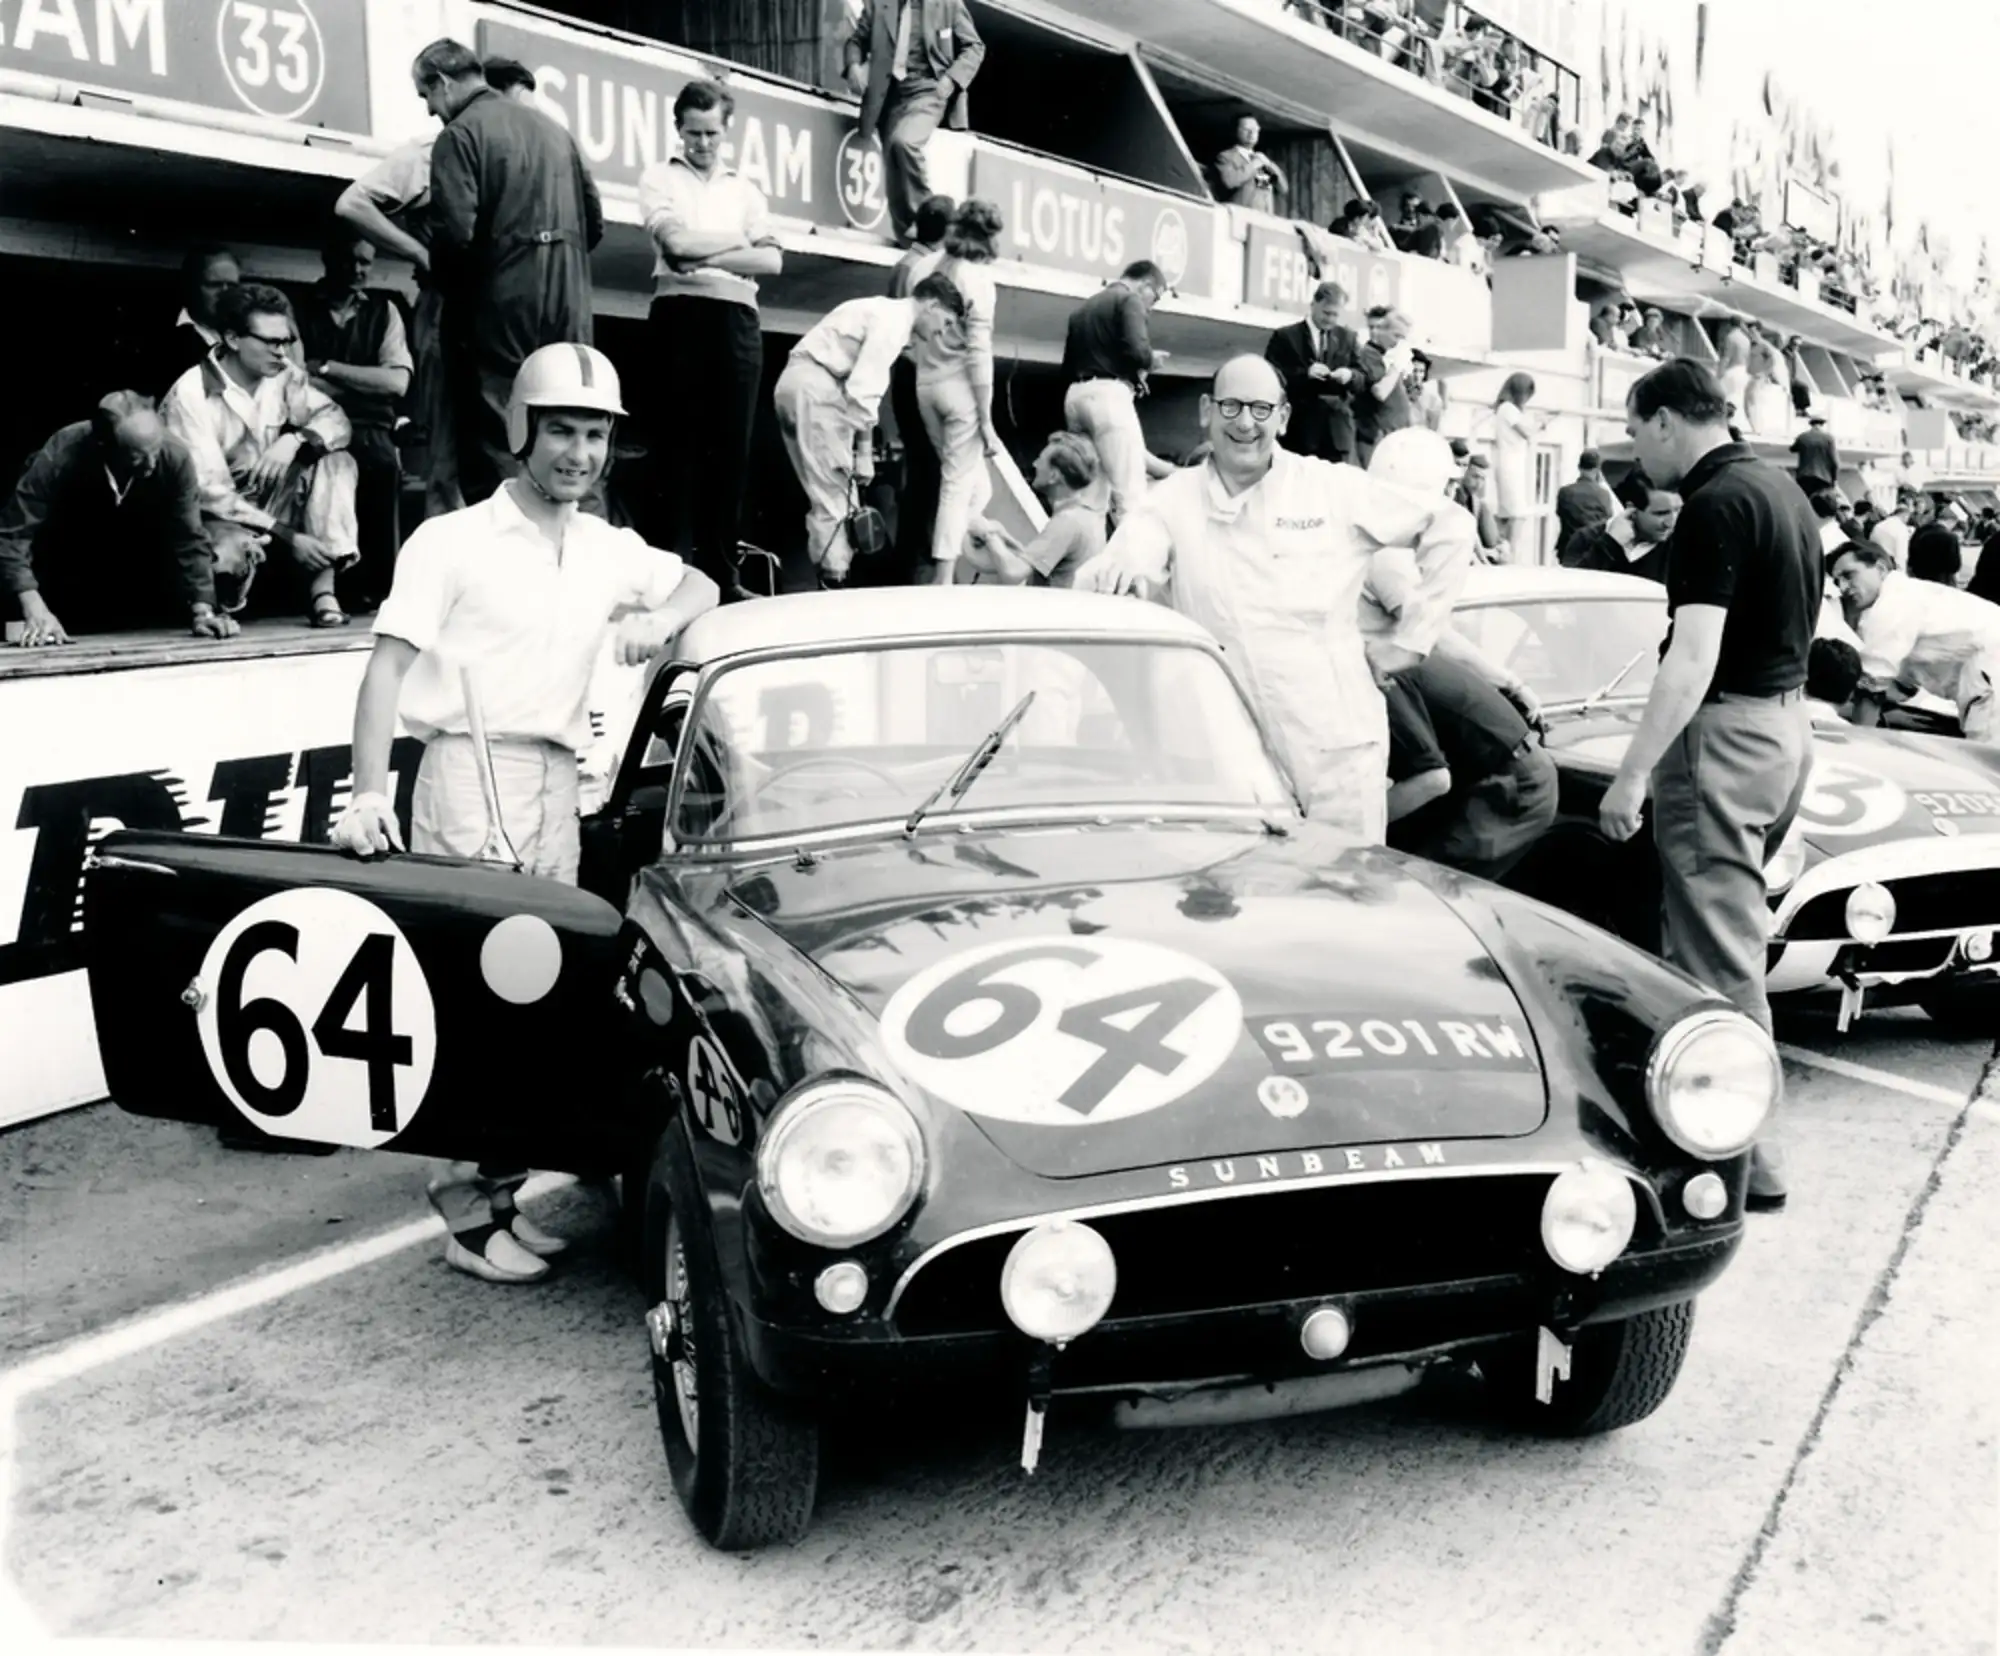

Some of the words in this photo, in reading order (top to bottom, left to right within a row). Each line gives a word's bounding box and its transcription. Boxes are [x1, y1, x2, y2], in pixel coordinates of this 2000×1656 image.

[0, 0, 167, 76] AM
[233, 1, 309, 93] 33
[533, 65, 812, 203] SUNAM
[1013, 180, 1124, 266] LOTUS
[216, 919, 413, 1133] 64
[904, 945, 1225, 1117] 64
[1264, 1019, 1439, 1062] 9201
[1168, 1143, 1446, 1188] SUNBEAM
